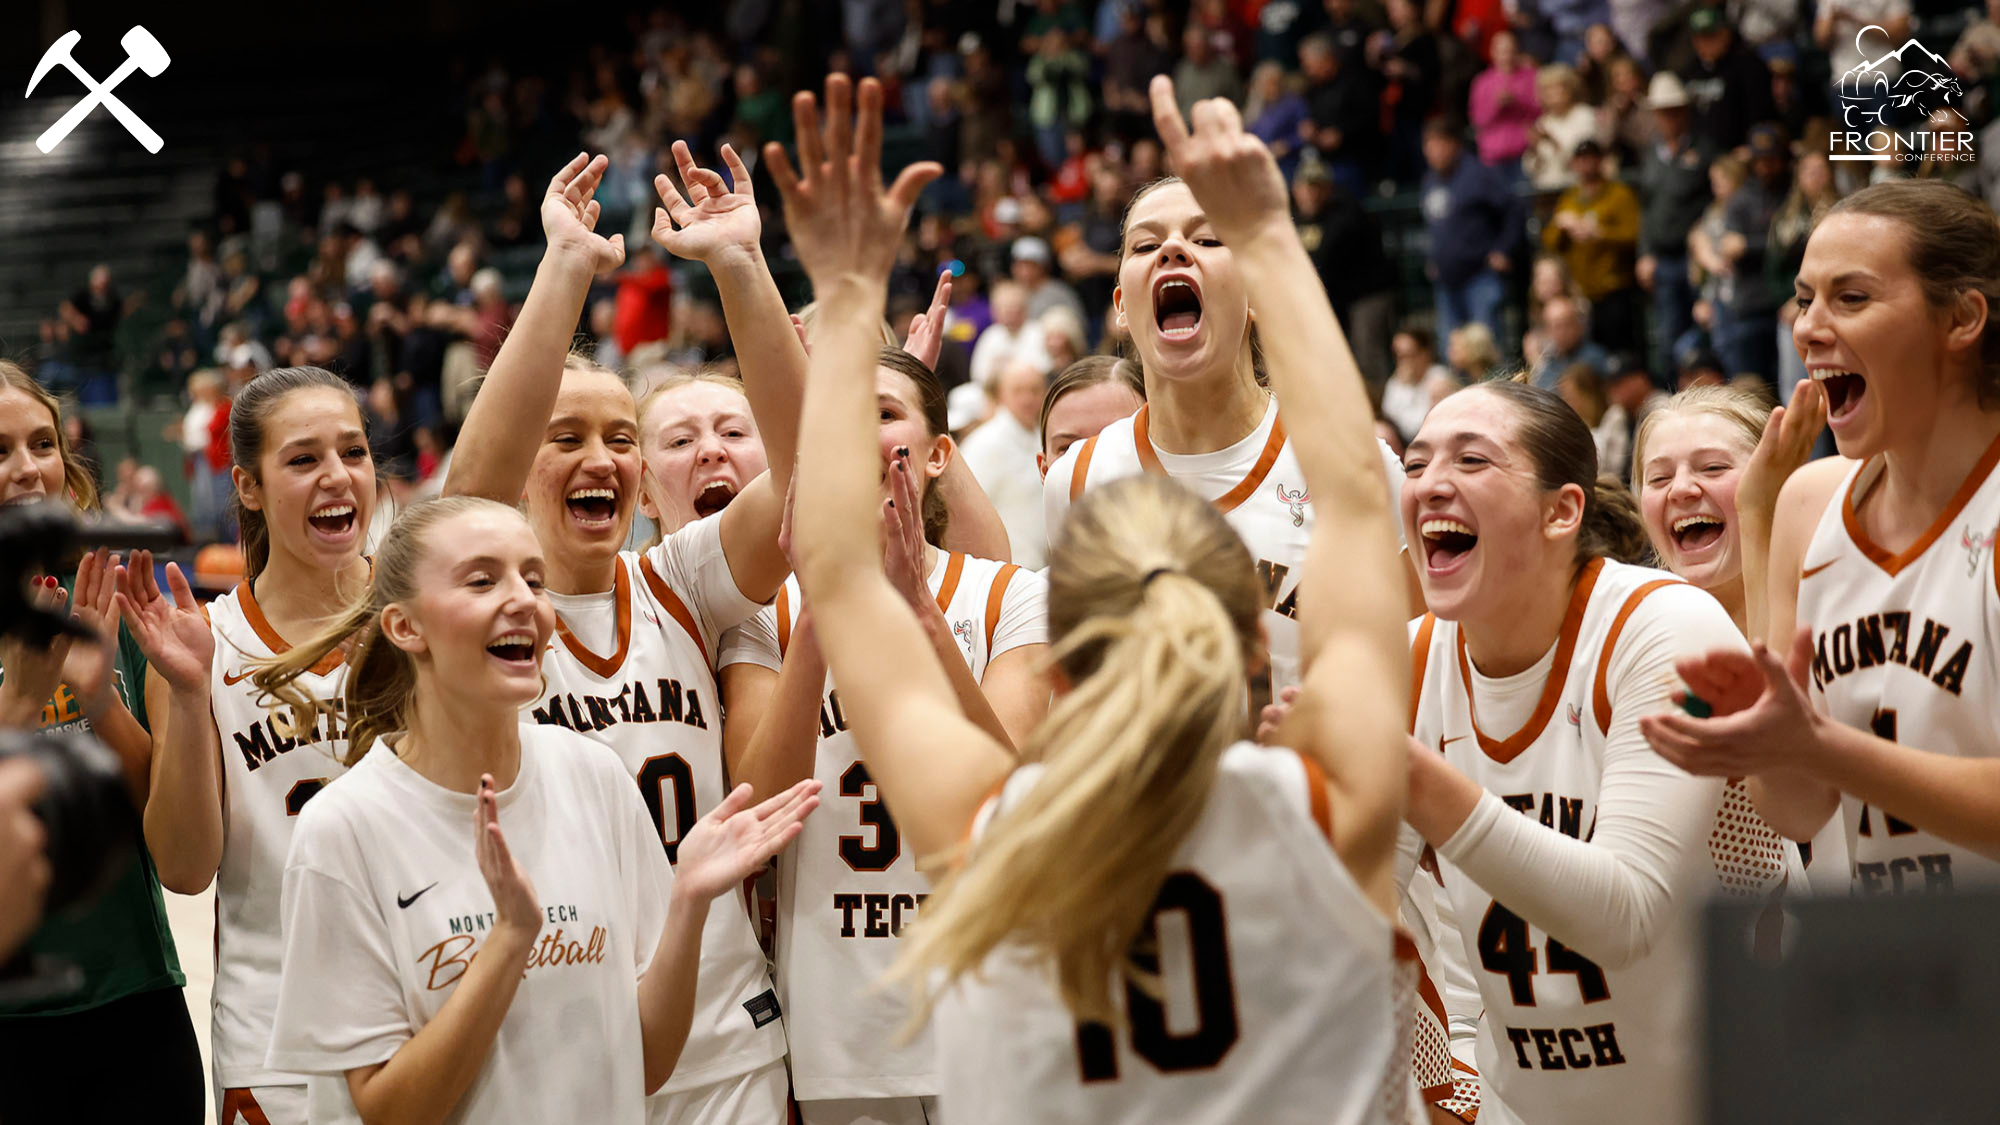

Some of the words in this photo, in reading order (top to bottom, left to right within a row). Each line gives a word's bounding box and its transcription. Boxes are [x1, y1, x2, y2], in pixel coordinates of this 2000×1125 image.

[838, 760, 901, 872] 3
[449, 912, 495, 935] MONT
[540, 904, 579, 924] ECH
[833, 893, 936, 938] TEC
[1505, 1022, 1627, 1071] TECH
